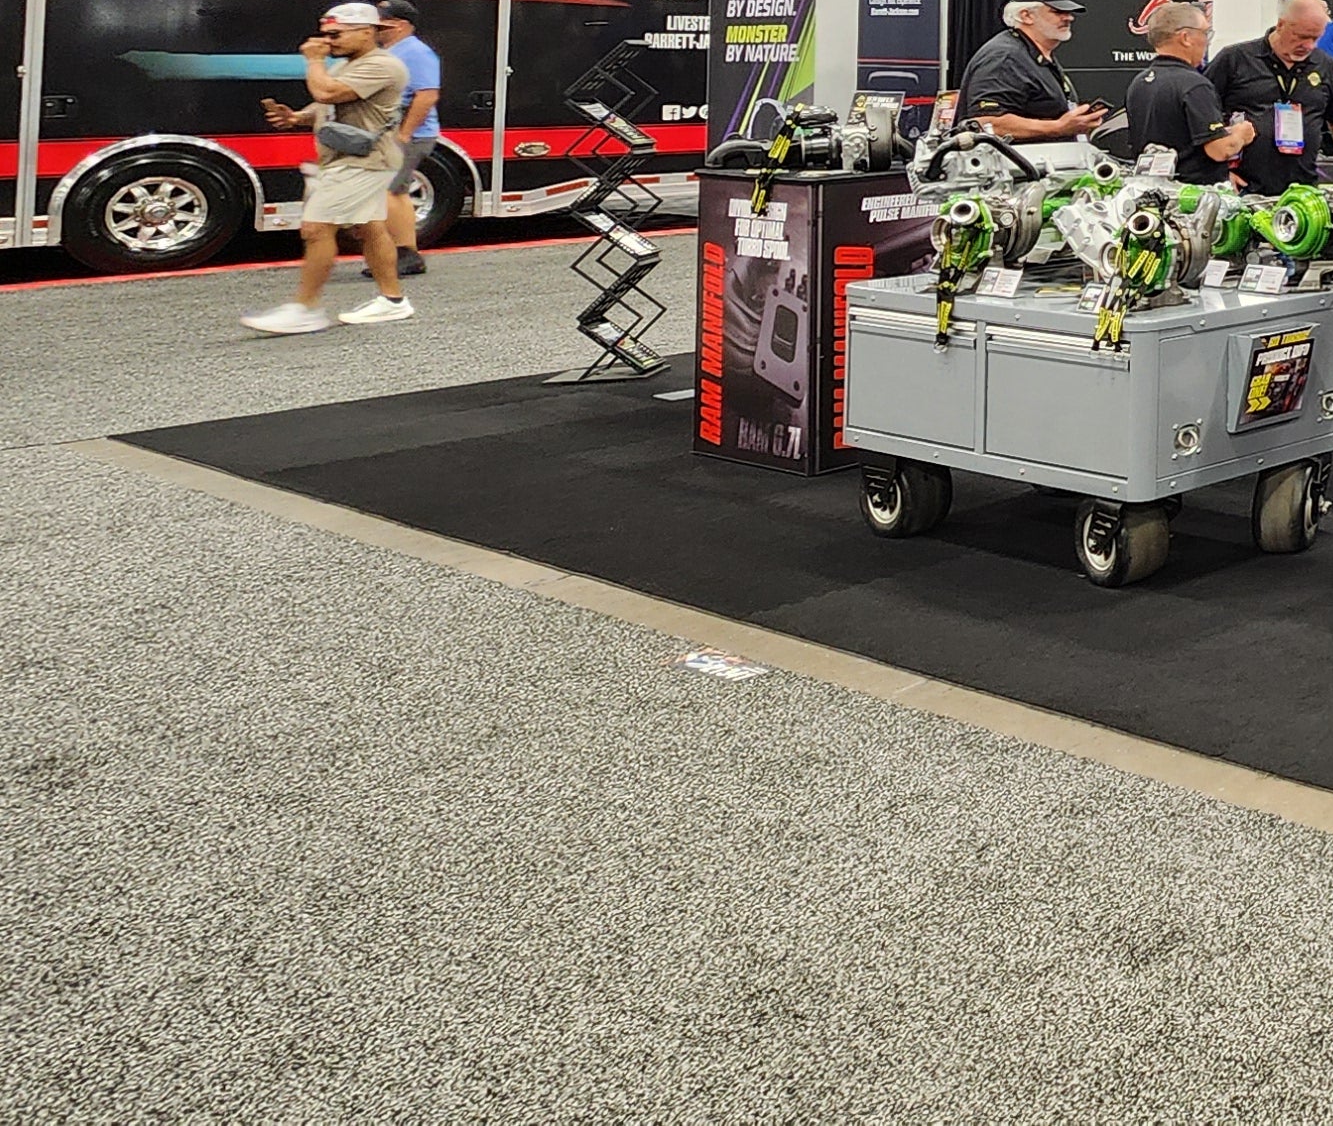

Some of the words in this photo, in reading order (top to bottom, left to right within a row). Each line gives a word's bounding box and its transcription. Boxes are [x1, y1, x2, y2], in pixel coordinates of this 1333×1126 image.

[726, 0, 744, 18] BY
[726, 24, 788, 43] MONSTER
[726, 44, 744, 62] BY
[745, 43, 800, 63] NATURE.
[1112, 51, 1134, 61] THE
[869, 207, 900, 223] PULSE
[901, 204, 940, 220] MANIFOL
[701, 242, 726, 378] MANIFOLD
[1255, 346, 1292, 366] PRODUCT
[700, 379, 722, 445] RAM
